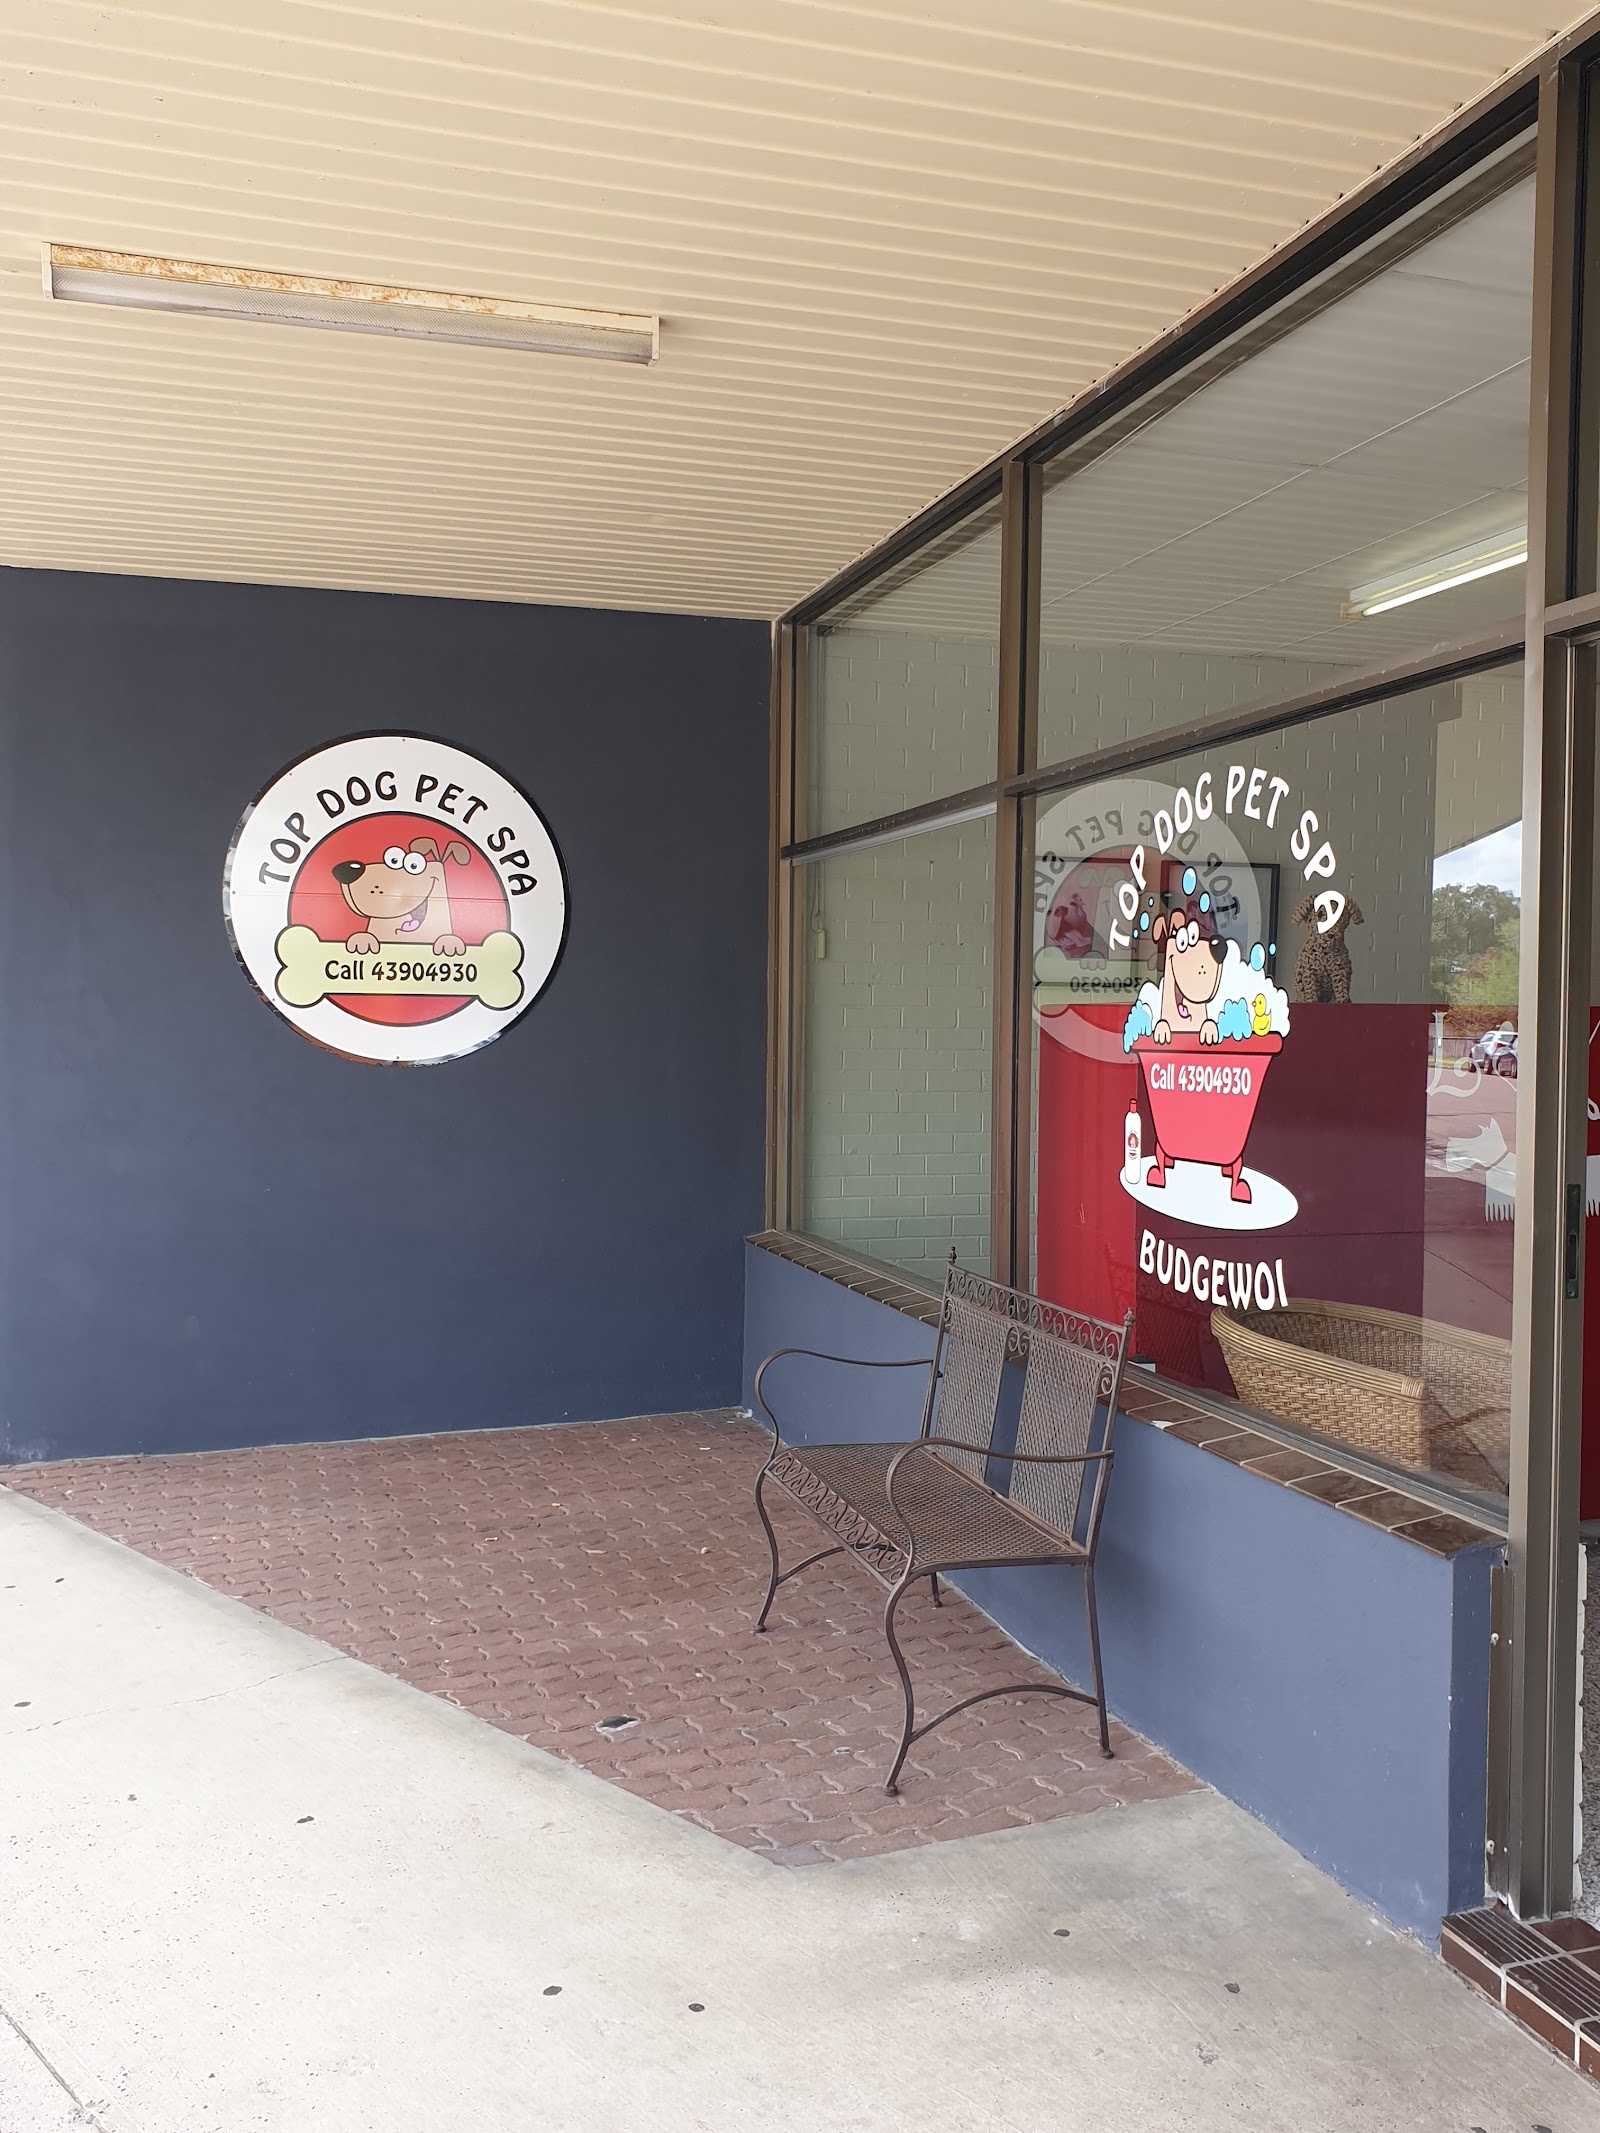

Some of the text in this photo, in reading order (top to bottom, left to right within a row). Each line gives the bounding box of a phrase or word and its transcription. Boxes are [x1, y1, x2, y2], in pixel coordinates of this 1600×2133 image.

[258, 771, 538, 896] TOP DOG PET SPA
[1109, 765, 1345, 951] TOP DOG PET SPA
[324, 960, 478, 982] Call 43904930
[1150, 1062, 1252, 1096] Call 43904930
[1139, 1228, 1289, 1311] BUDGEWOI
